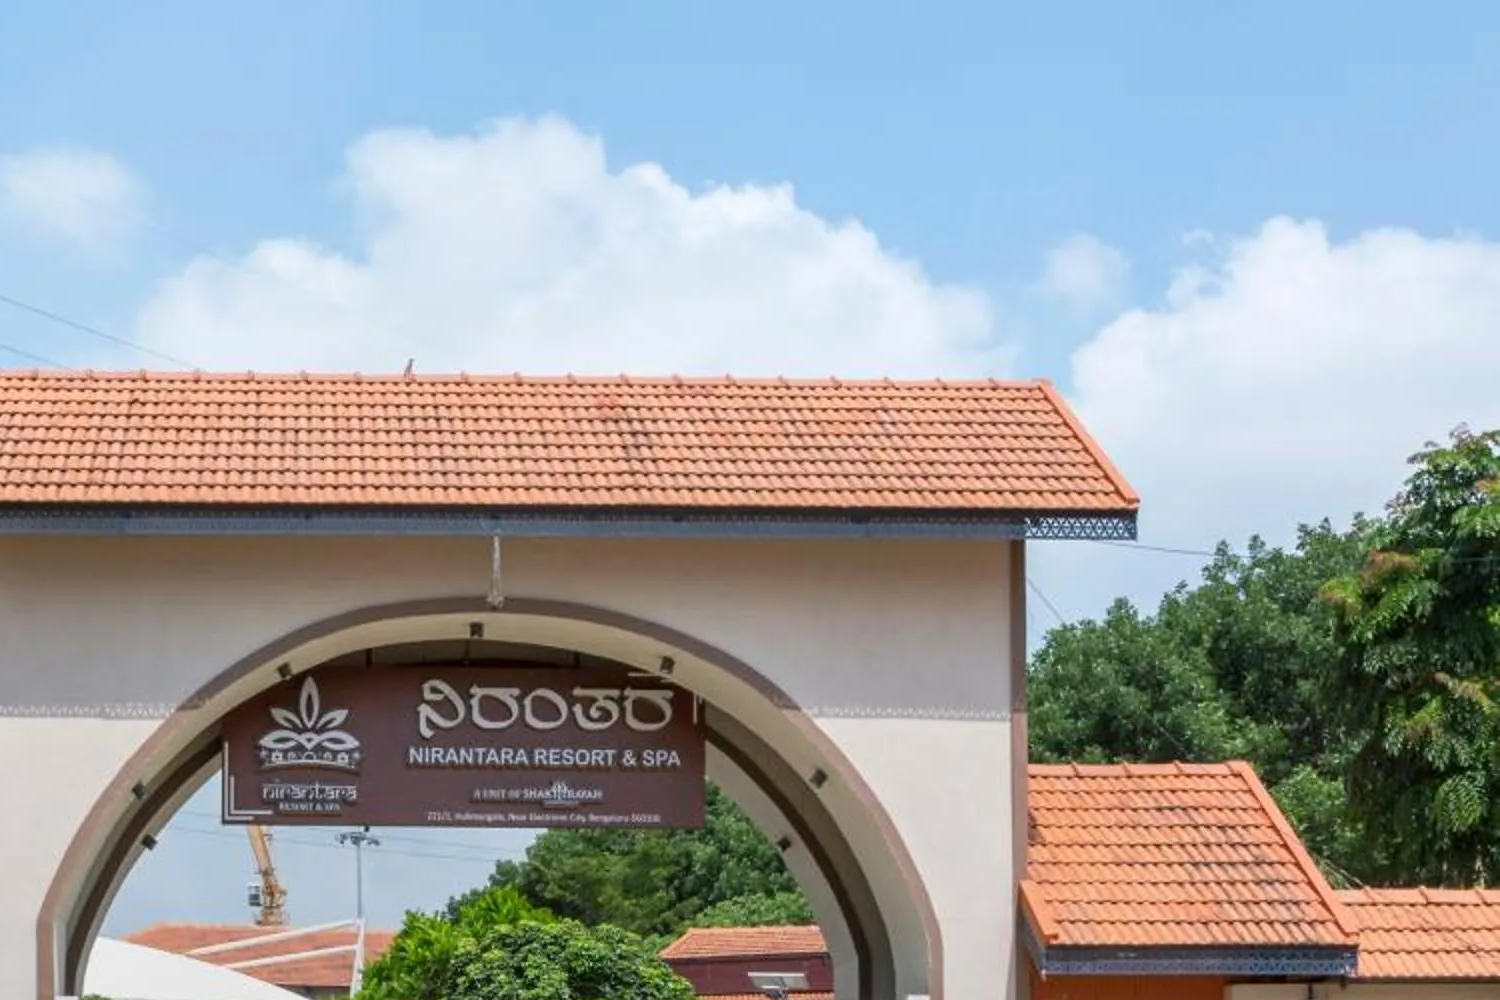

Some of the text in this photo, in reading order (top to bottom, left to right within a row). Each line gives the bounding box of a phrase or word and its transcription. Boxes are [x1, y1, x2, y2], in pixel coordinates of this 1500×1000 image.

[417, 679, 674, 739] ನಿರಂತರ
[409, 747, 681, 767] NIRANTARA RESORT & SPA
